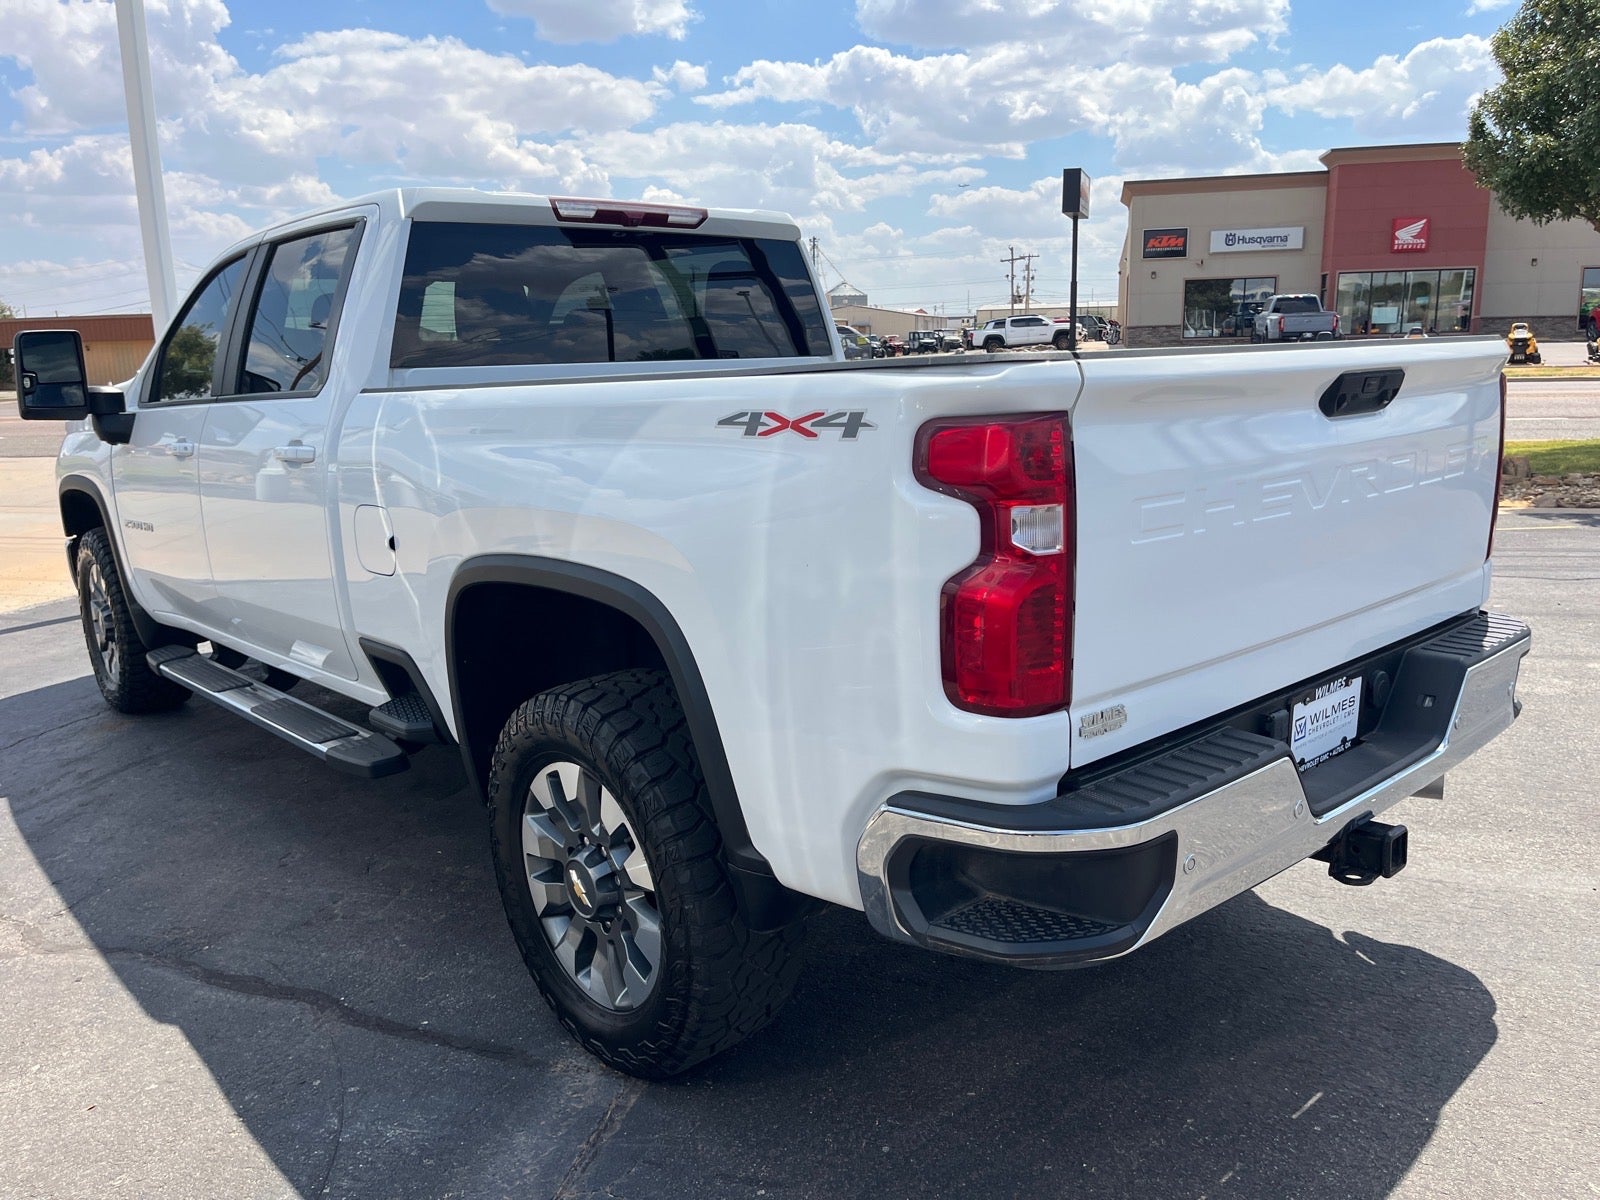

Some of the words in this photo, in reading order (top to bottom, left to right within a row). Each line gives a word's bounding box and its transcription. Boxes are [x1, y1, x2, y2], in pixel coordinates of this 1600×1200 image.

[1147, 236, 1185, 248] KTM
[1237, 235, 1288, 245] Husqvarna
[1131, 436, 1489, 545] CHEVROLET
[1315, 677, 1347, 700] WILMES
[1081, 704, 1126, 728] WILMES
[1310, 696, 1356, 725] WILMES
[1308, 716, 1339, 736] CHEVROLET
[1298, 757, 1320, 772] HEVROLET
